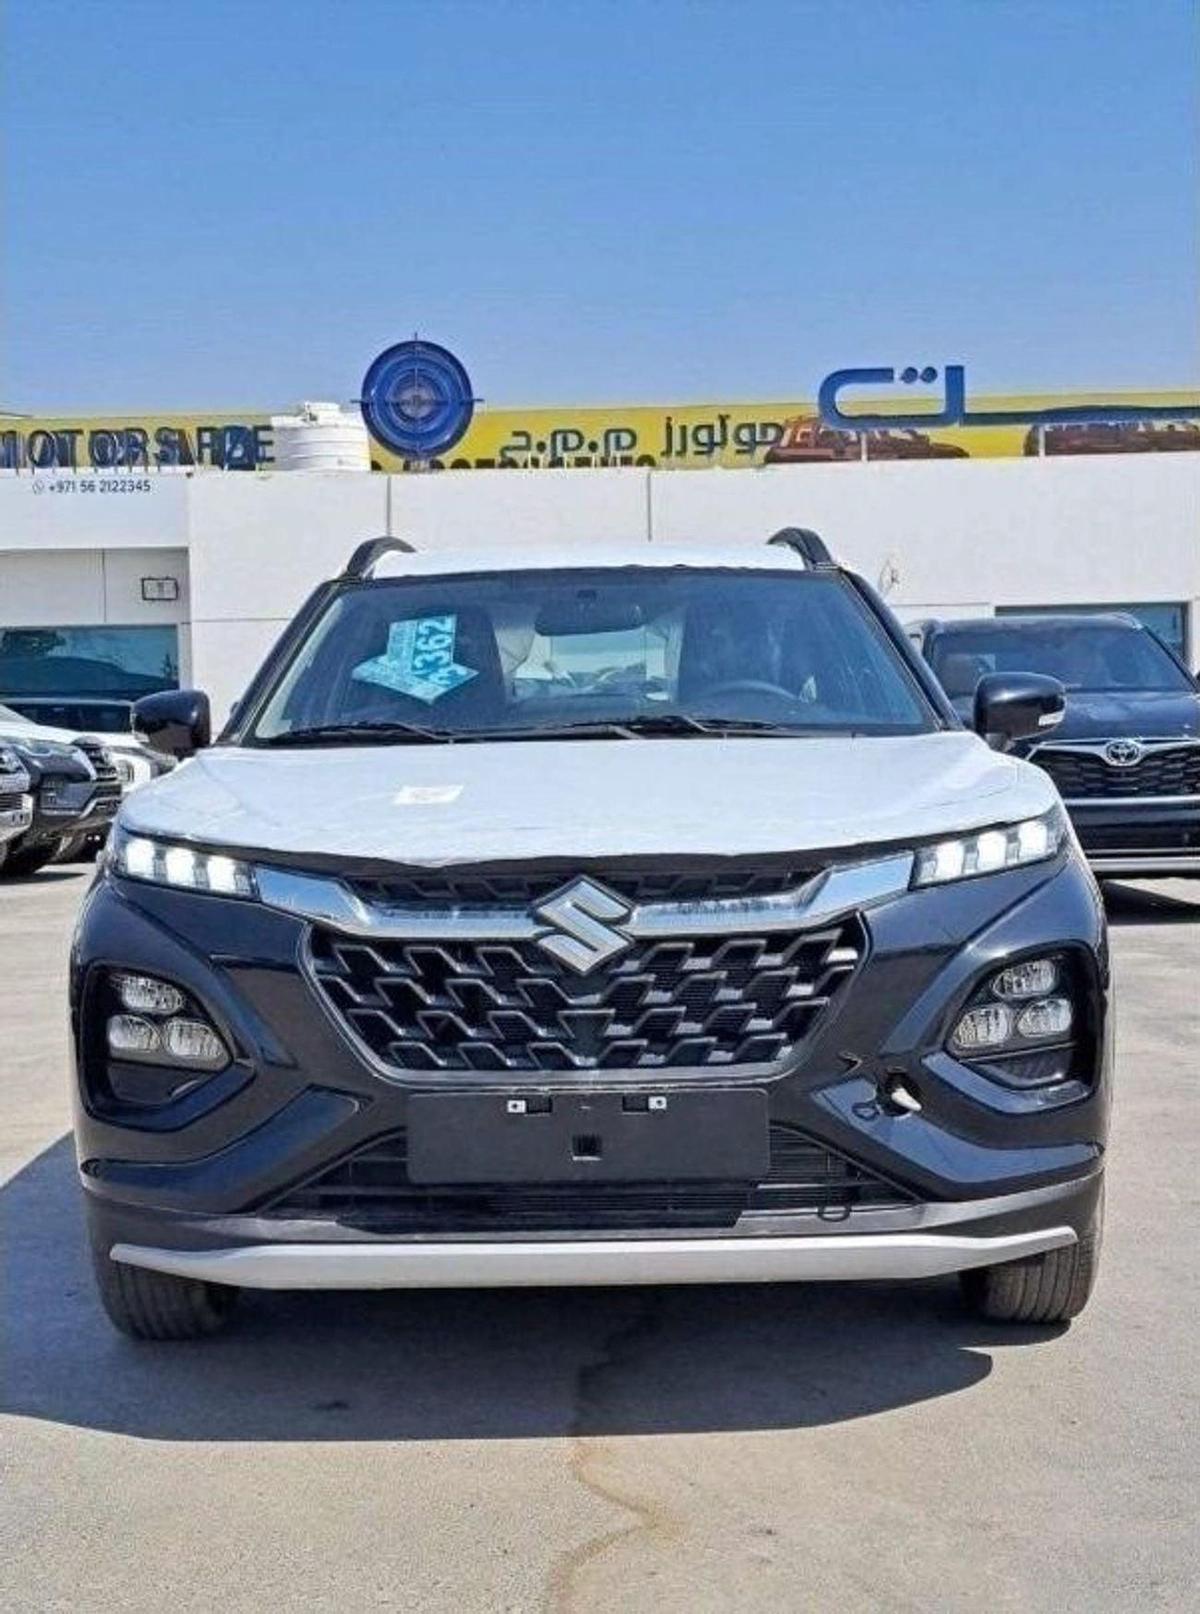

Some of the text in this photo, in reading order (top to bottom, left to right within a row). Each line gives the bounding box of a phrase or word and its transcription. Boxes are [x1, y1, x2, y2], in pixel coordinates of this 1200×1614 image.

[48, 478, 152, 494] +971 56 2122345
